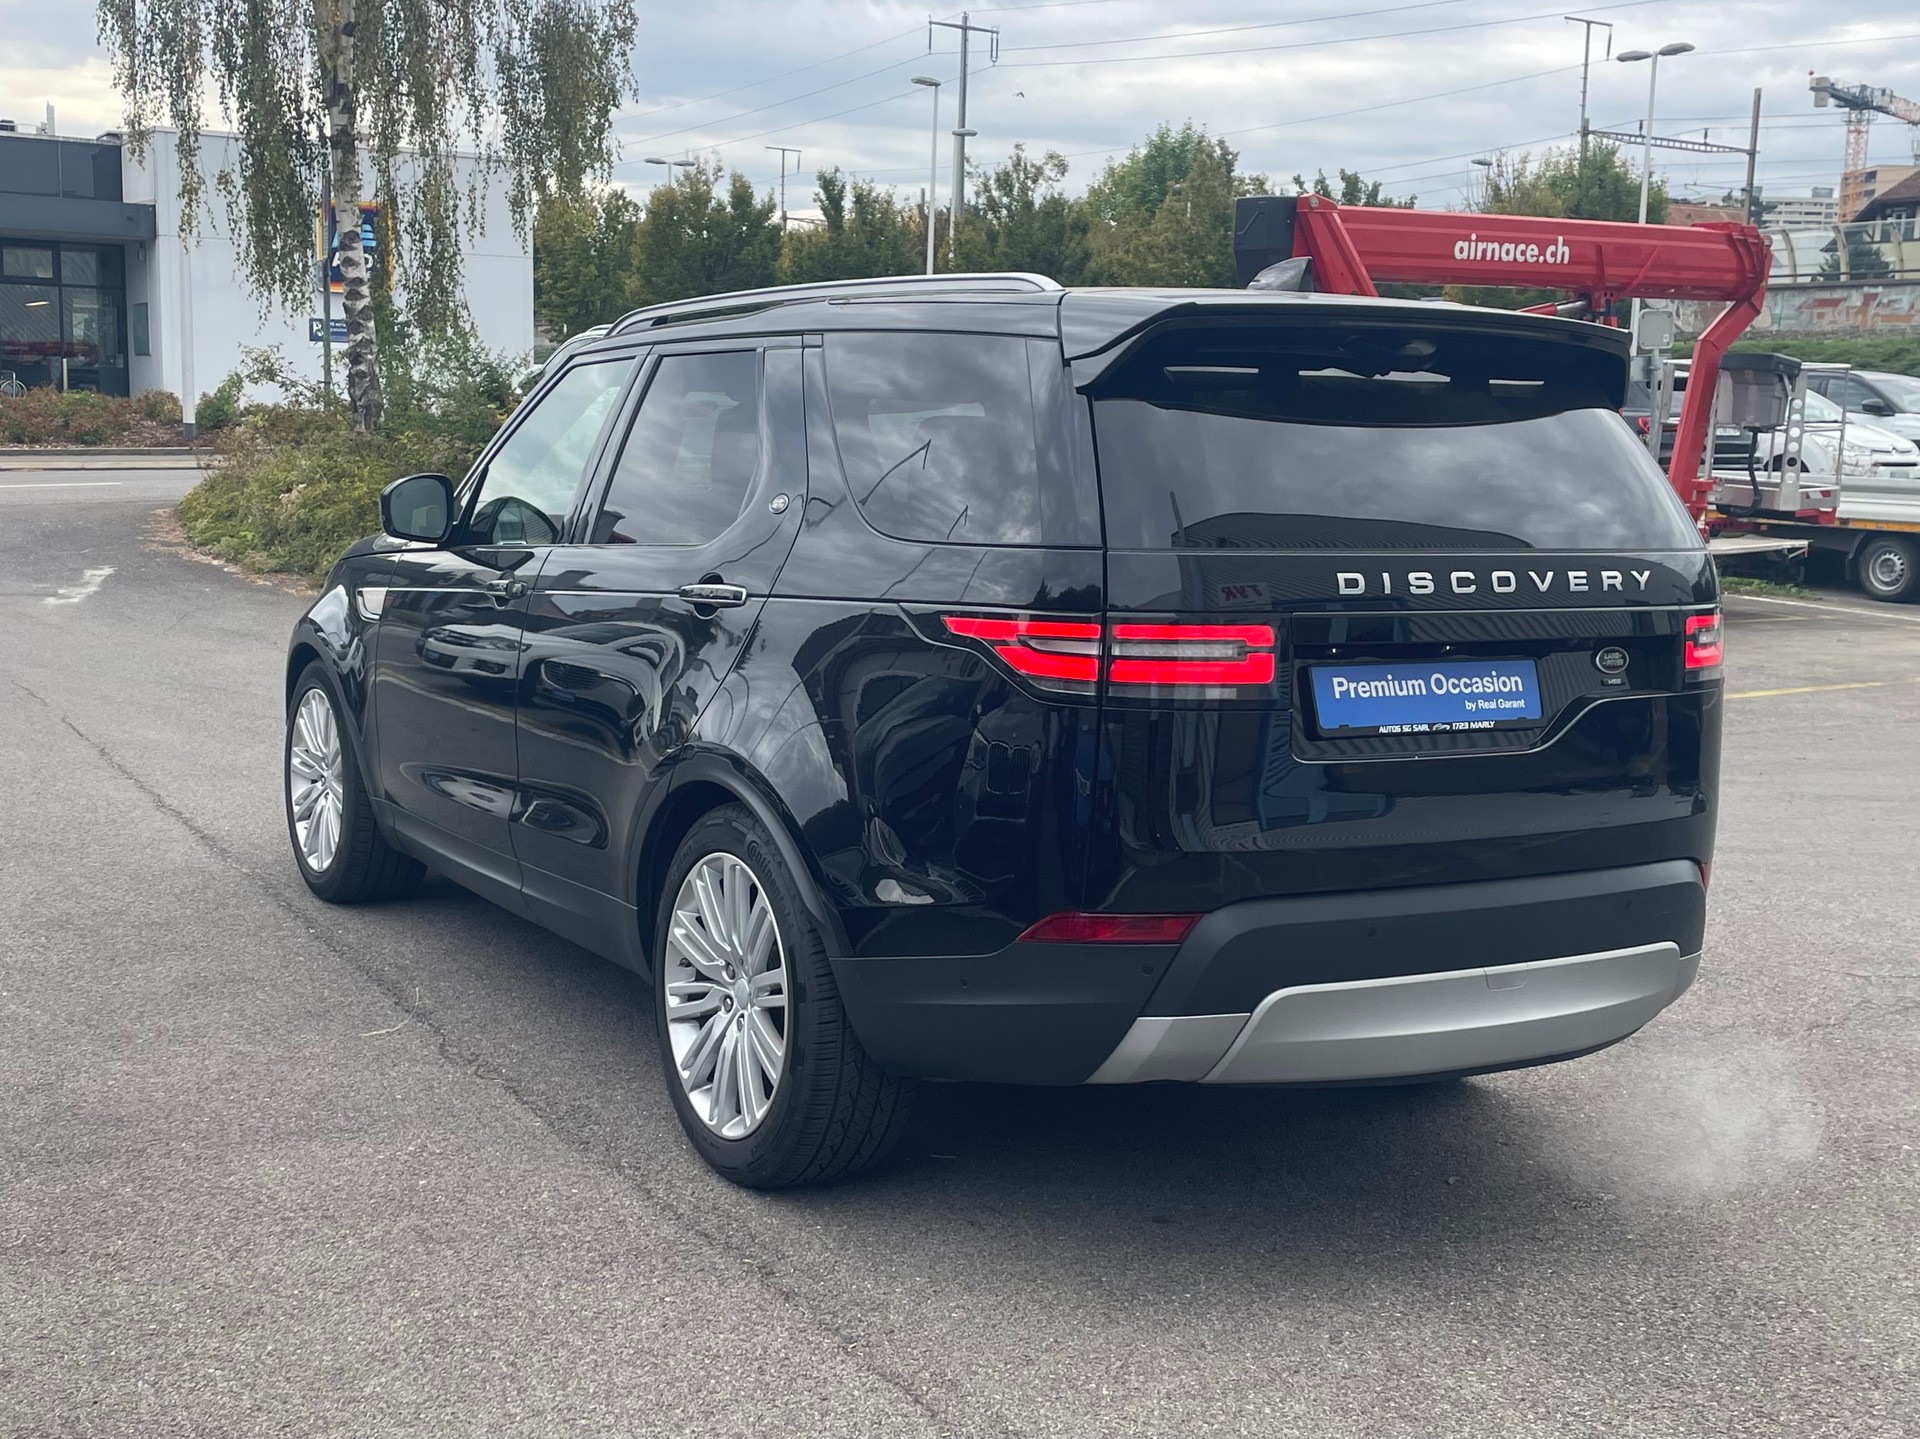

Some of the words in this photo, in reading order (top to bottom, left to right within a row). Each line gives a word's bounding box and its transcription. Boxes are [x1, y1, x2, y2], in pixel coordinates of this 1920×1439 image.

[1454, 232, 1570, 265] airnace.ch
[1336, 569, 1653, 596] DISCOVERY
[1332, 674, 1427, 699] Premium
[1430, 670, 1524, 696] Occasion
[1465, 700, 1477, 711] by
[1478, 699, 1497, 710] Real
[1497, 698, 1526, 709] Garant
[1378, 725, 1401, 734] AUTOS
[1412, 724, 1430, 733] SARL
[1452, 721, 1469, 730] 1723
[1470, 720, 1496, 730] MARLY
